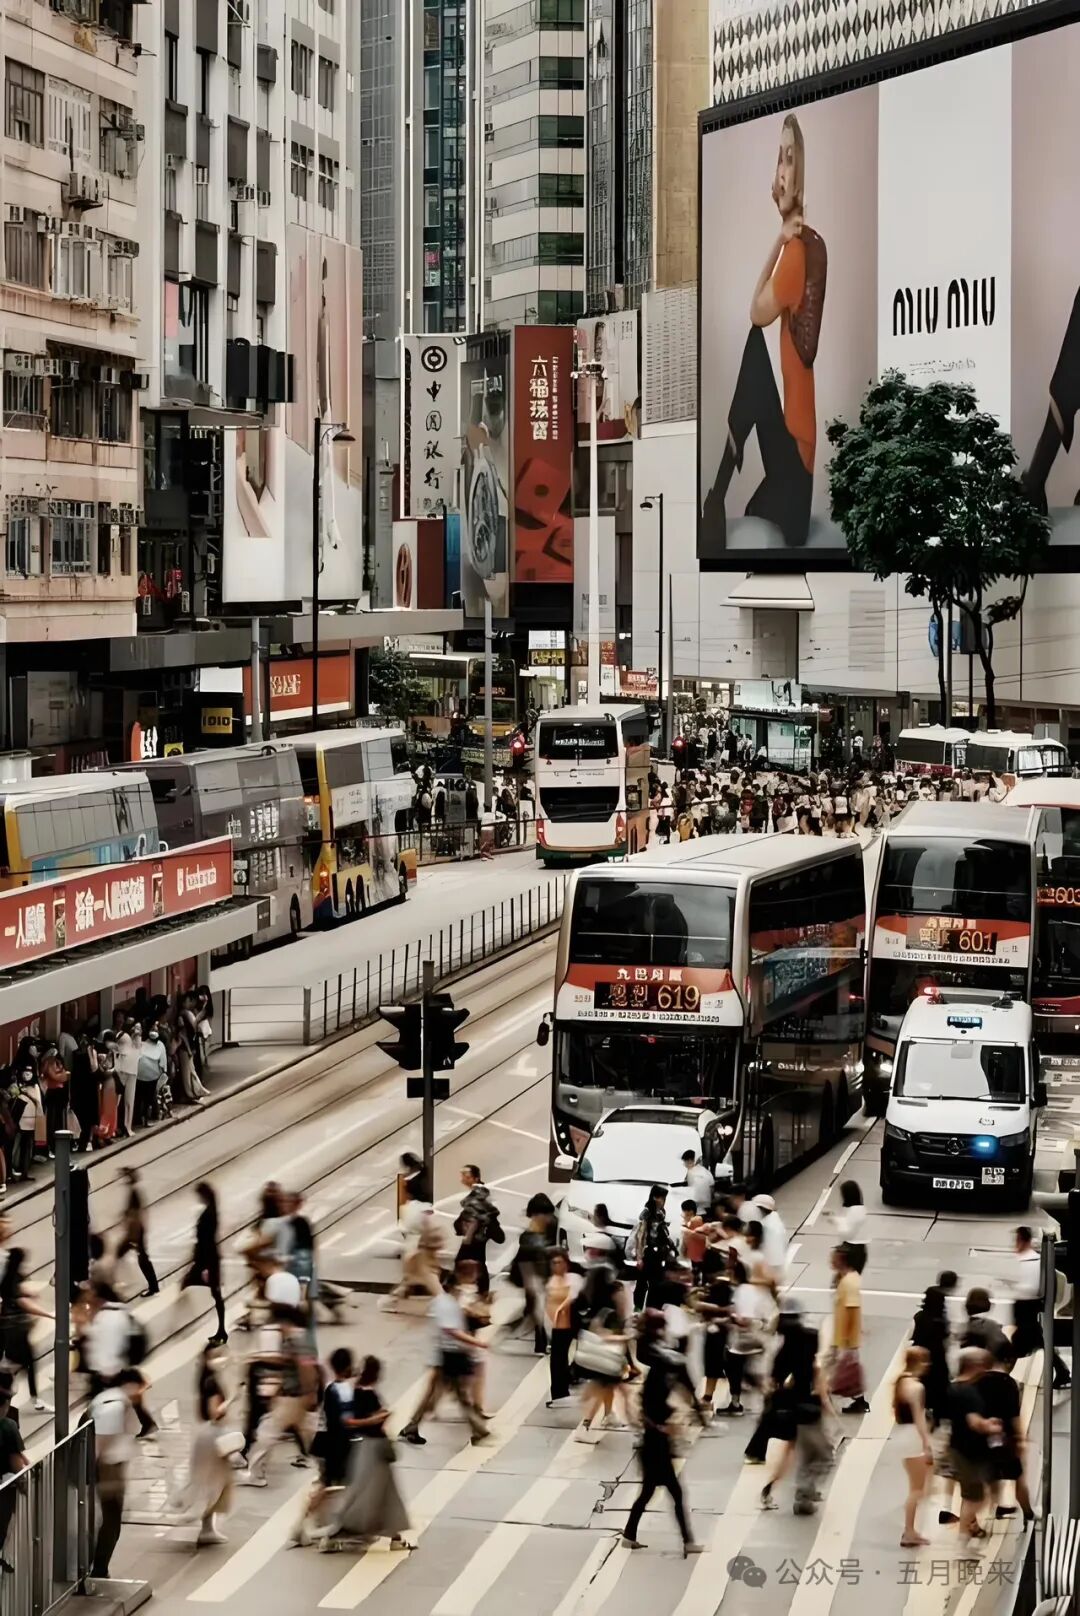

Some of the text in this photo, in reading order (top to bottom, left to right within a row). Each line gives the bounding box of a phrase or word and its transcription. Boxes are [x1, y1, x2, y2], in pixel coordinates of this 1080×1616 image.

[893, 277, 995, 336] MIU MIU
[958, 930, 993, 953] 601
[657, 984, 700, 1011] 619
